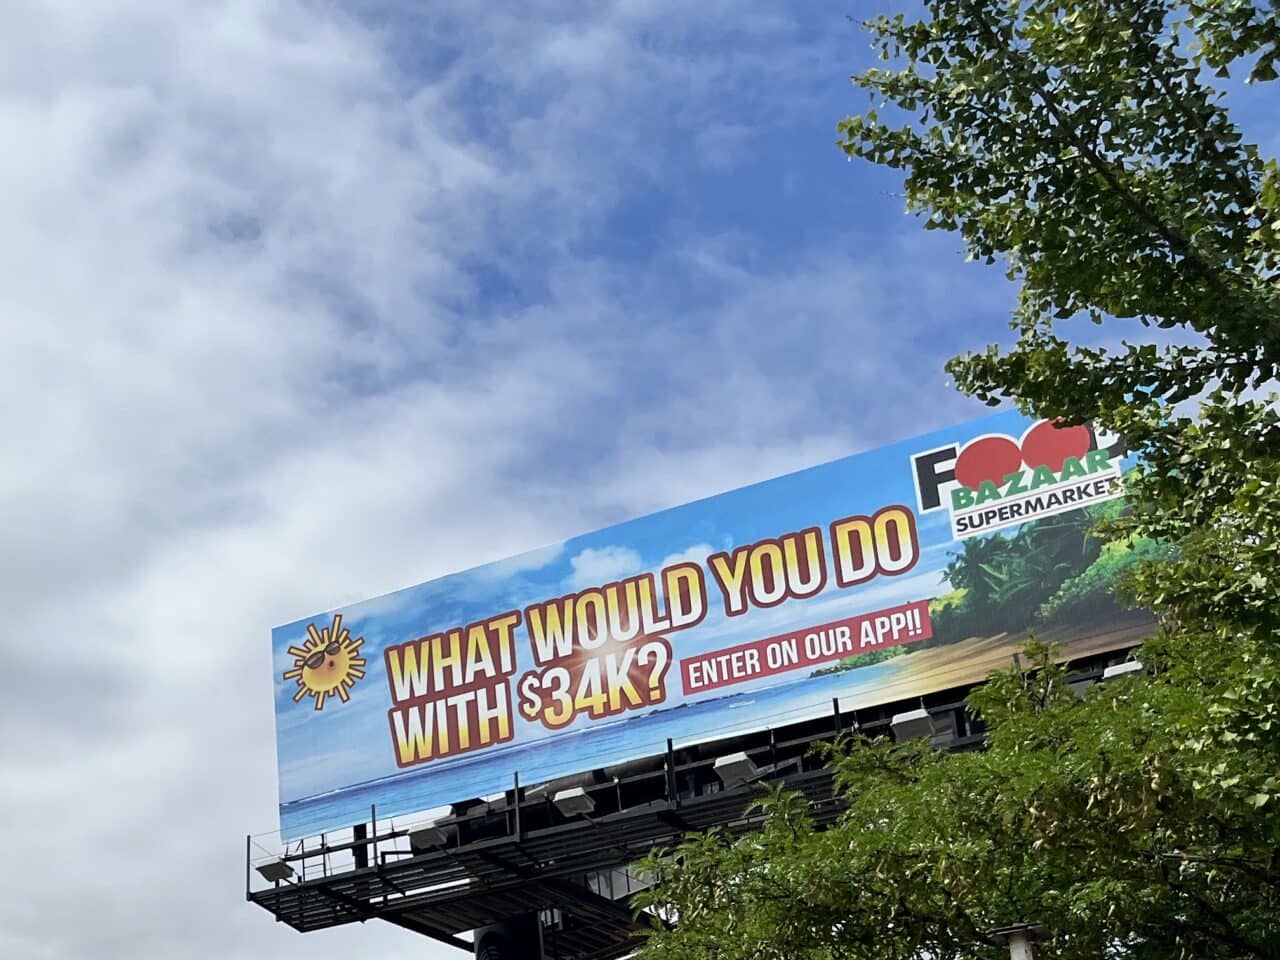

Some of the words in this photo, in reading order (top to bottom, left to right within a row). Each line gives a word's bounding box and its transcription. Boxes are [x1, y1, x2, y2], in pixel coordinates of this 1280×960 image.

[951, 449, 1114, 511] BAZAAR
[387, 613, 520, 703] WHAT
[528, 566, 705, 664] WOULD
[712, 525, 823, 614] YOU
[833, 506, 917, 586] DO
[688, 648, 761, 689] ENTER
[767, 638, 799, 670] ON
[804, 625, 852, 660] OUR
[860, 607, 922, 648] APP!!
[391, 681, 511, 765] WITH
[520, 641, 668, 727] $34K?
